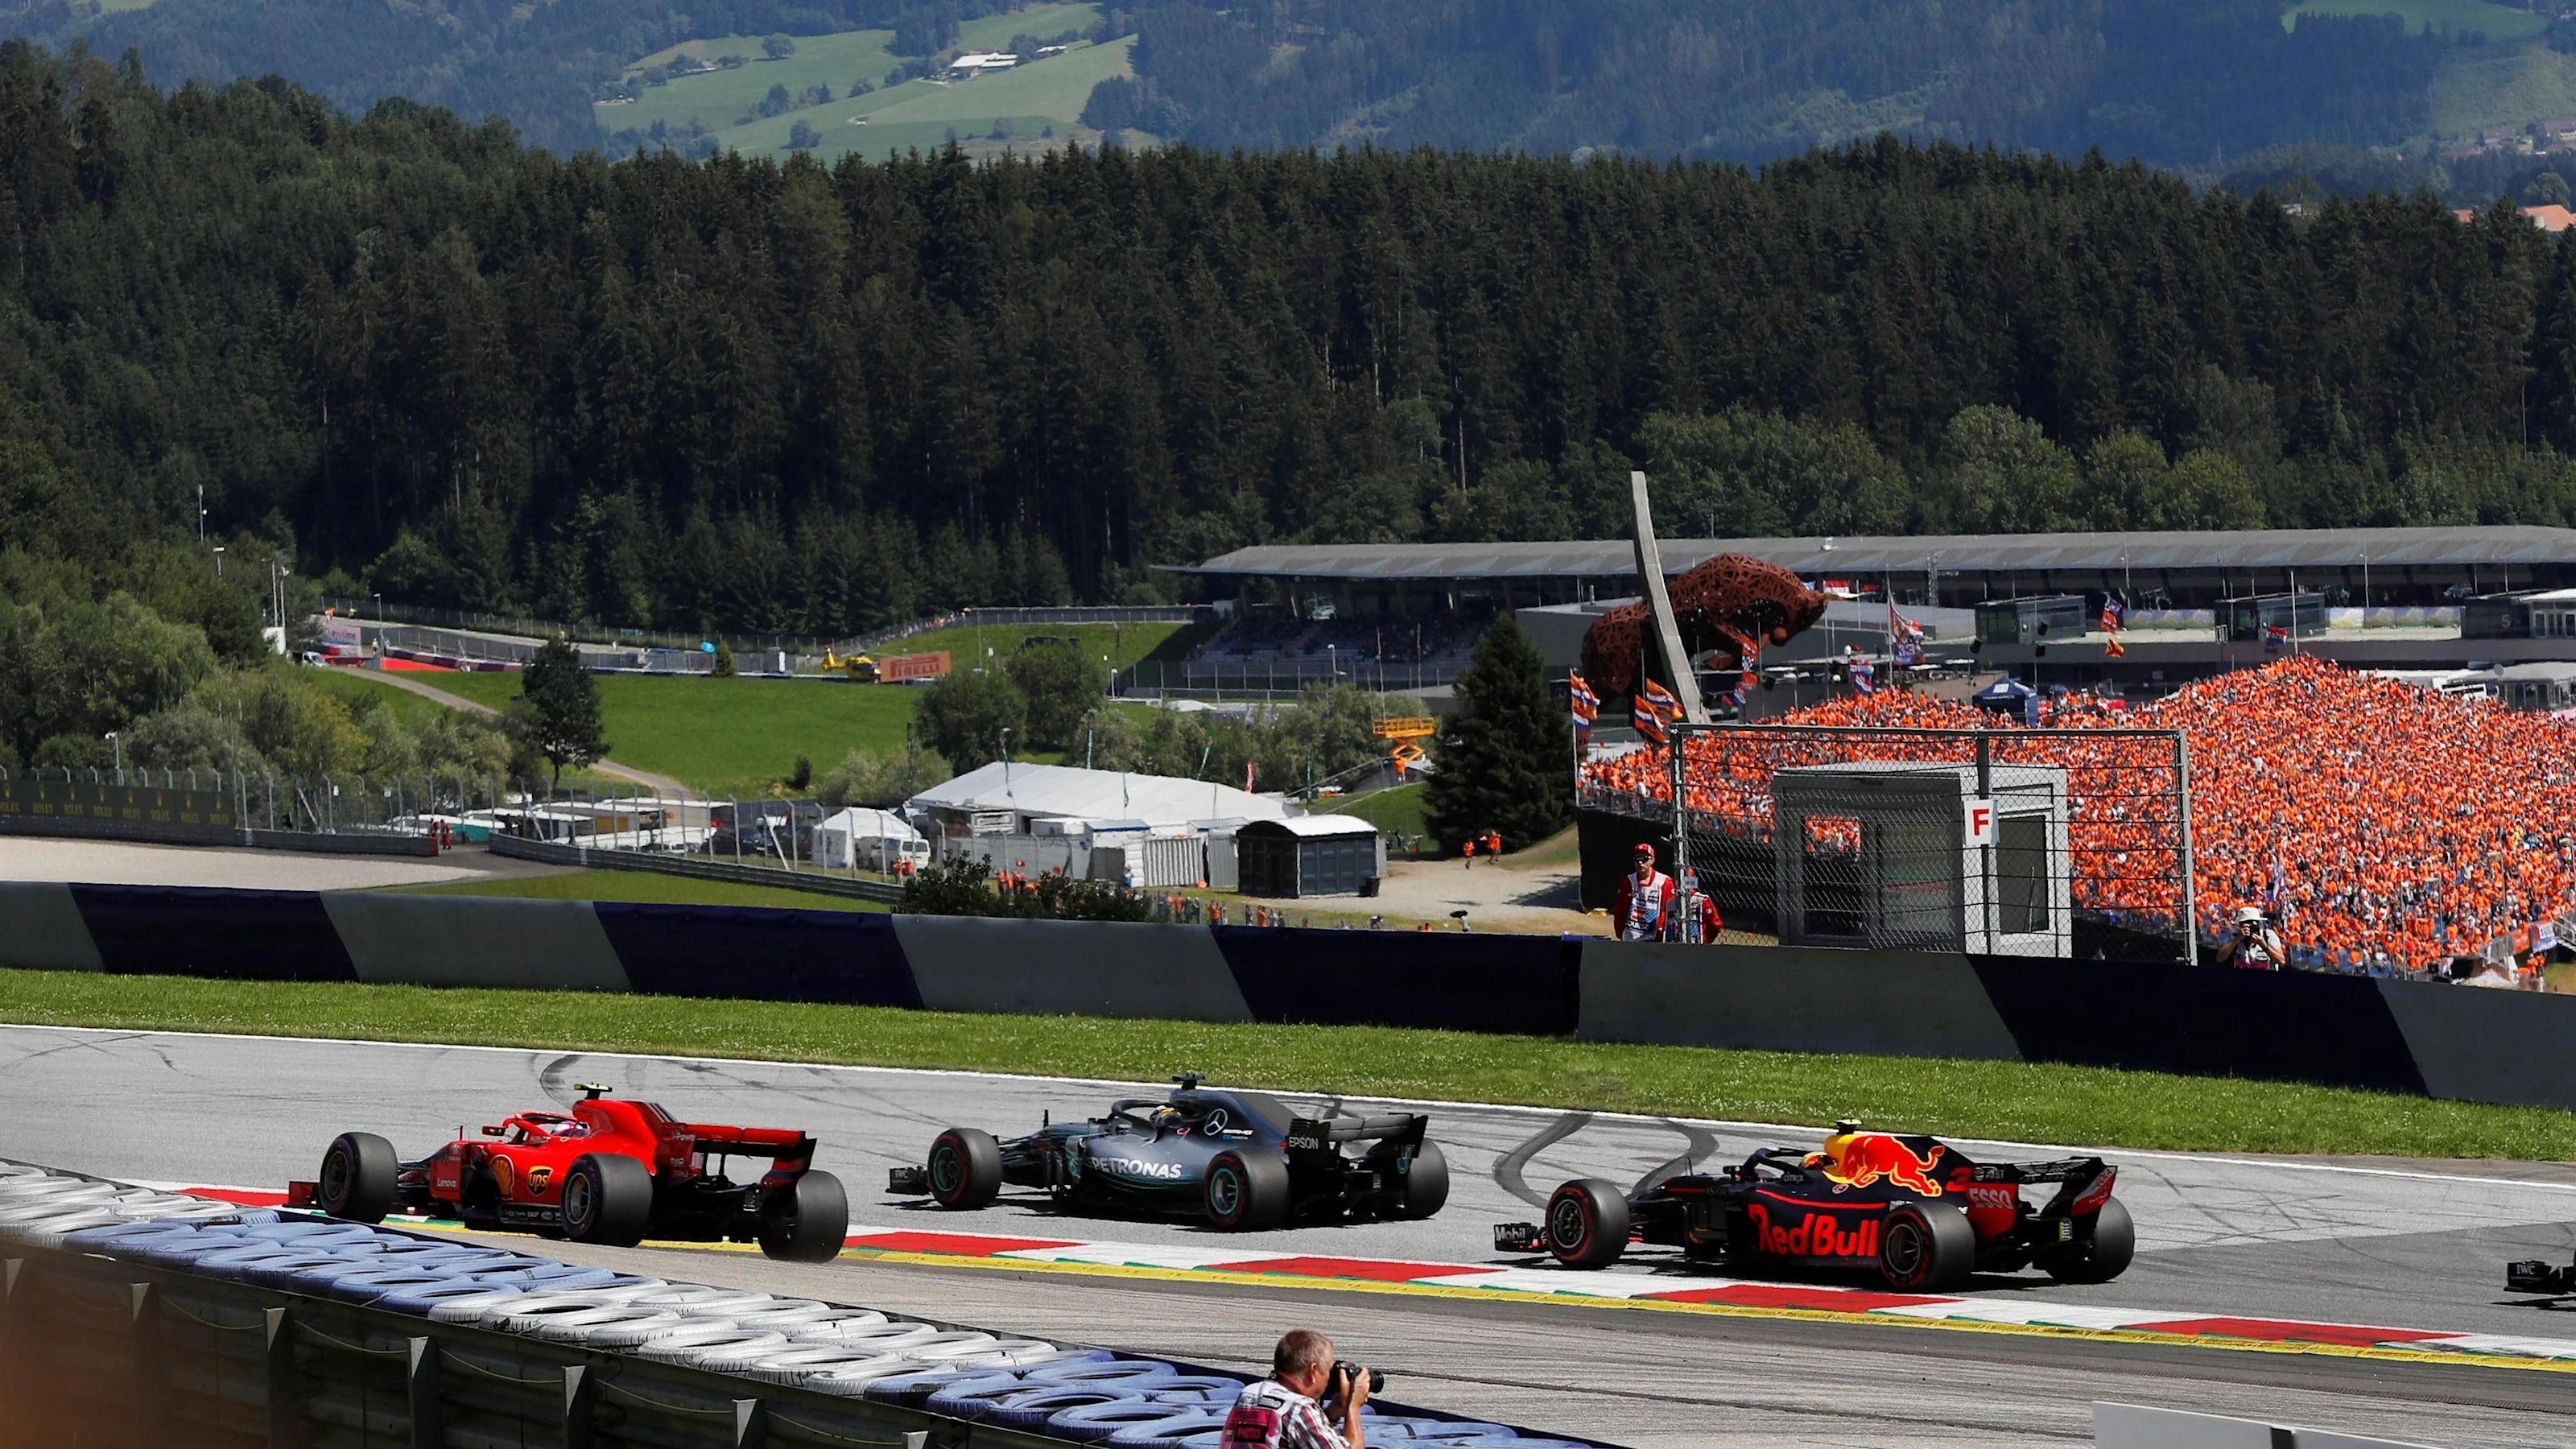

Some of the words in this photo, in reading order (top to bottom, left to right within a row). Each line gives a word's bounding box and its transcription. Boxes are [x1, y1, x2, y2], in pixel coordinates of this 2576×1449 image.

[1972, 808, 1989, 836] F
[1289, 1137, 1319, 1150] EPSON
[1092, 1158, 1182, 1179] PETRONAS
[437, 1178, 456, 1187] Lenovo
[528, 1174, 548, 1191] ups
[1495, 1226, 1525, 1241] Mobil
[2516, 1264, 2536, 1275] IWC
